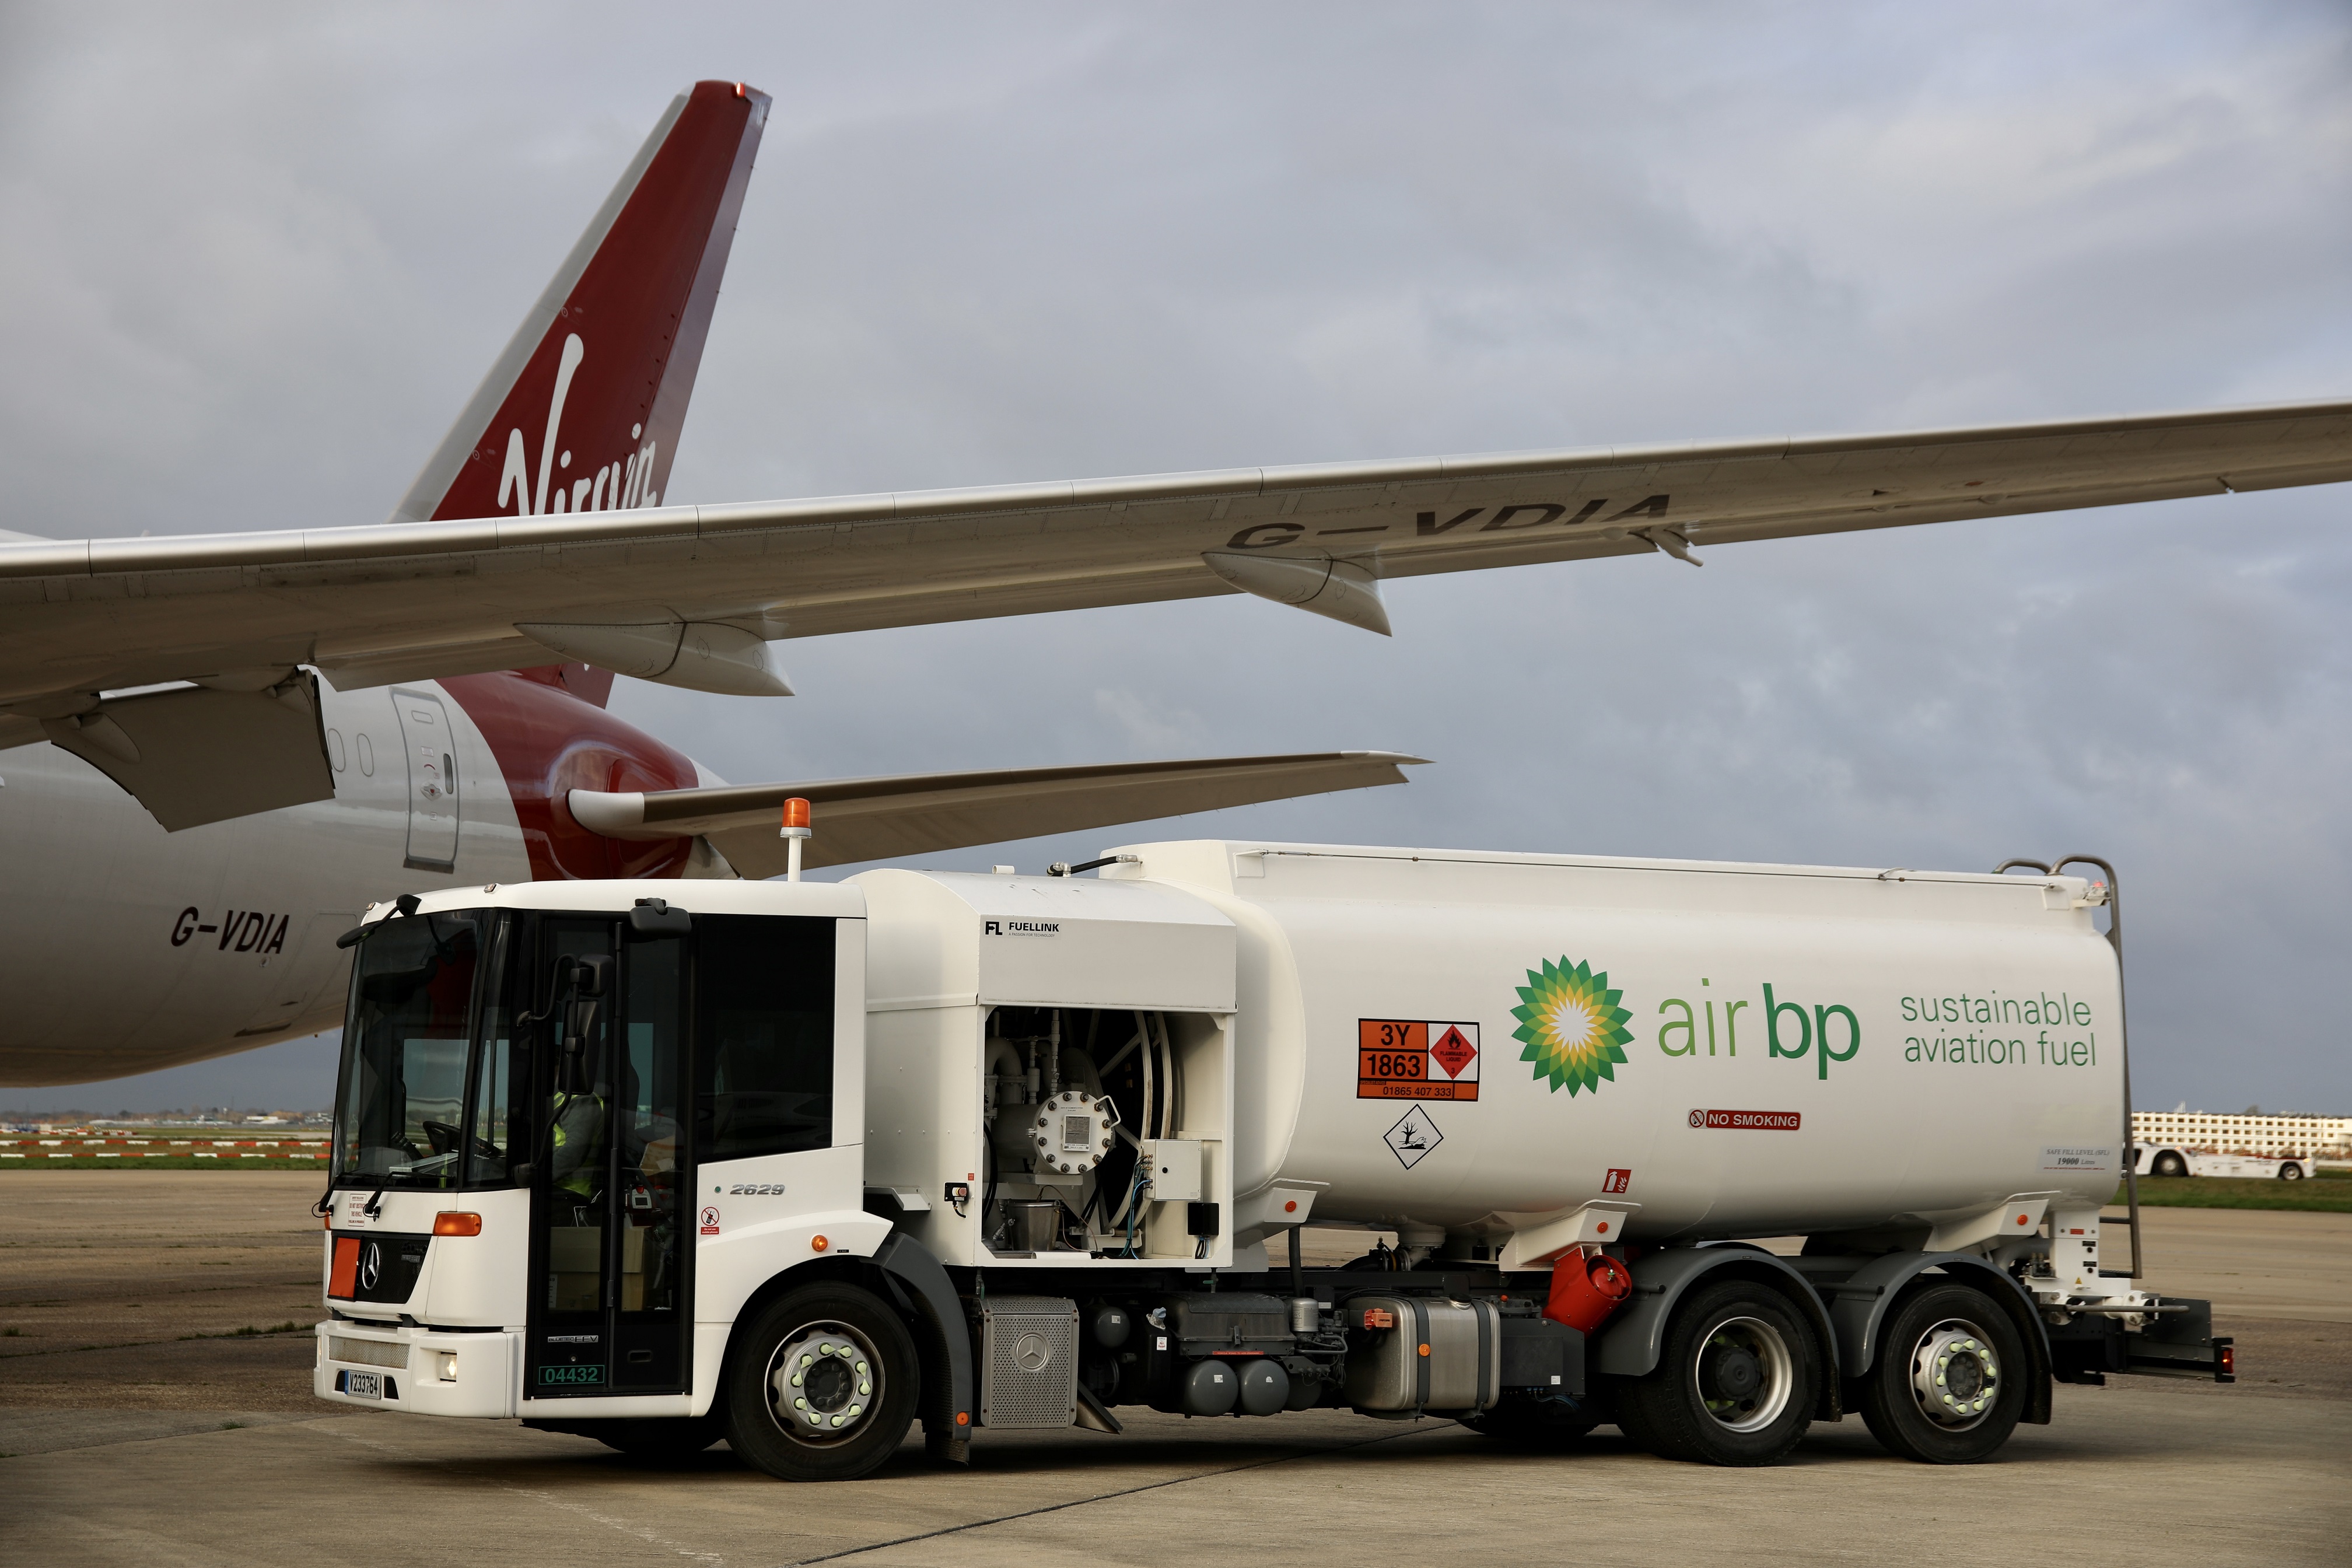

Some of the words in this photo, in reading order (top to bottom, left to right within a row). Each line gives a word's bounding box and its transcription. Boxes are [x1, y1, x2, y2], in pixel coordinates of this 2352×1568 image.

[171, 906, 289, 954] G-VDIA
[1009, 922, 1059, 932] FUELLINK
[1901, 990, 2091, 1026] sustainable
[1380, 1024, 1410, 1046] 3Y
[1658, 978, 1748, 1056] air
[1762, 982, 1861, 1080] bp
[1905, 1028, 2026, 1064] aviation
[2037, 1030, 2096, 1066] fuel
[1367, 1054, 1420, 1077] 1863
[1382, 1086, 1412, 1096] 01865
[1414, 1087, 1432, 1096] 407
[1434, 1087, 1451, 1097] 333
[1709, 1114, 1729, 1125] NO
[1733, 1114, 1798, 1127] SMOKING
[729, 1184, 785, 1195] 2629
[349, 1373, 378, 1395] V233764
[545, 1367, 598, 1382] 04432
